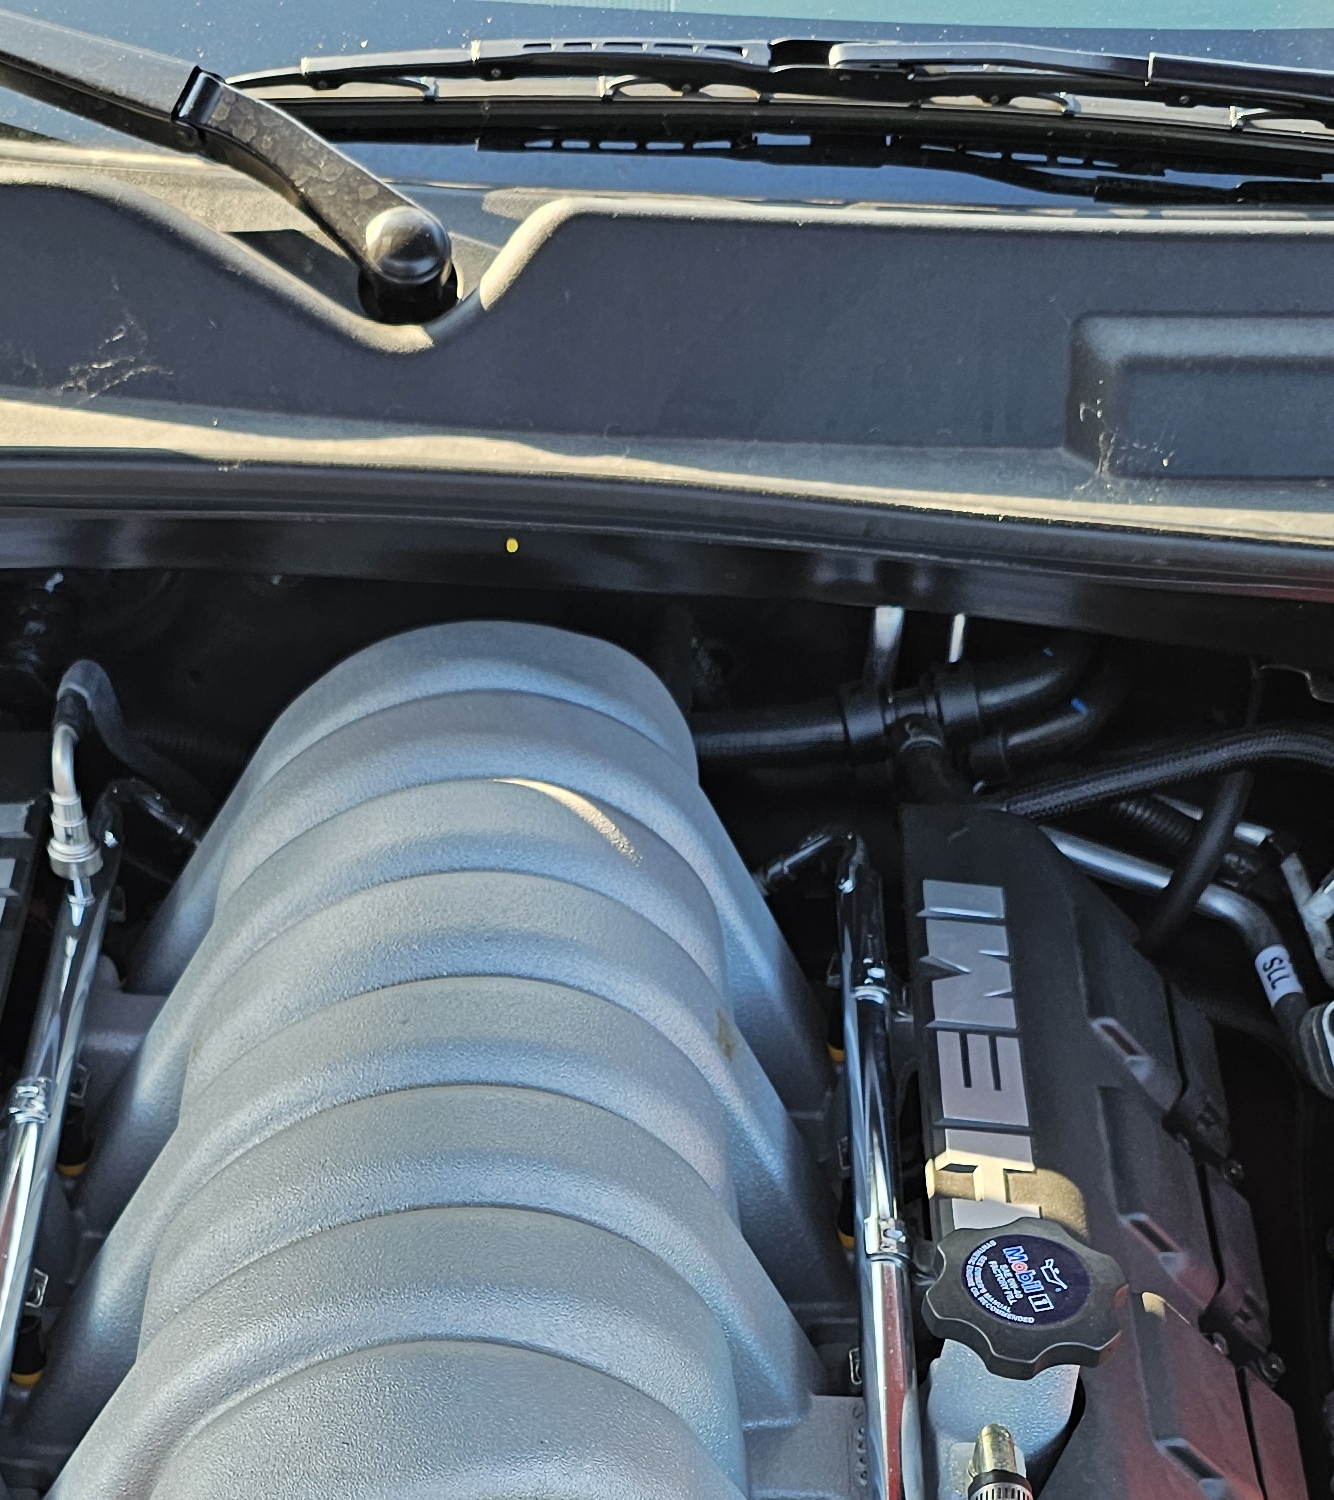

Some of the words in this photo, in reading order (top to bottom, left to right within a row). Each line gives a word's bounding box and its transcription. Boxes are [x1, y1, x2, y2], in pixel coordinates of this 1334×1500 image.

[919, 879, 1043, 1232] HEMI
[988, 1261, 1011, 1290] FACTORY
[1004, 1291, 1017, 1305] FILL
[1000, 1264, 1013, 1278] SAE
[1002, 1245, 1045, 1294] Mobil
[978, 1297, 1034, 1323] RECOMMENDED
[983, 1293, 1011, 1313] MANUAL
